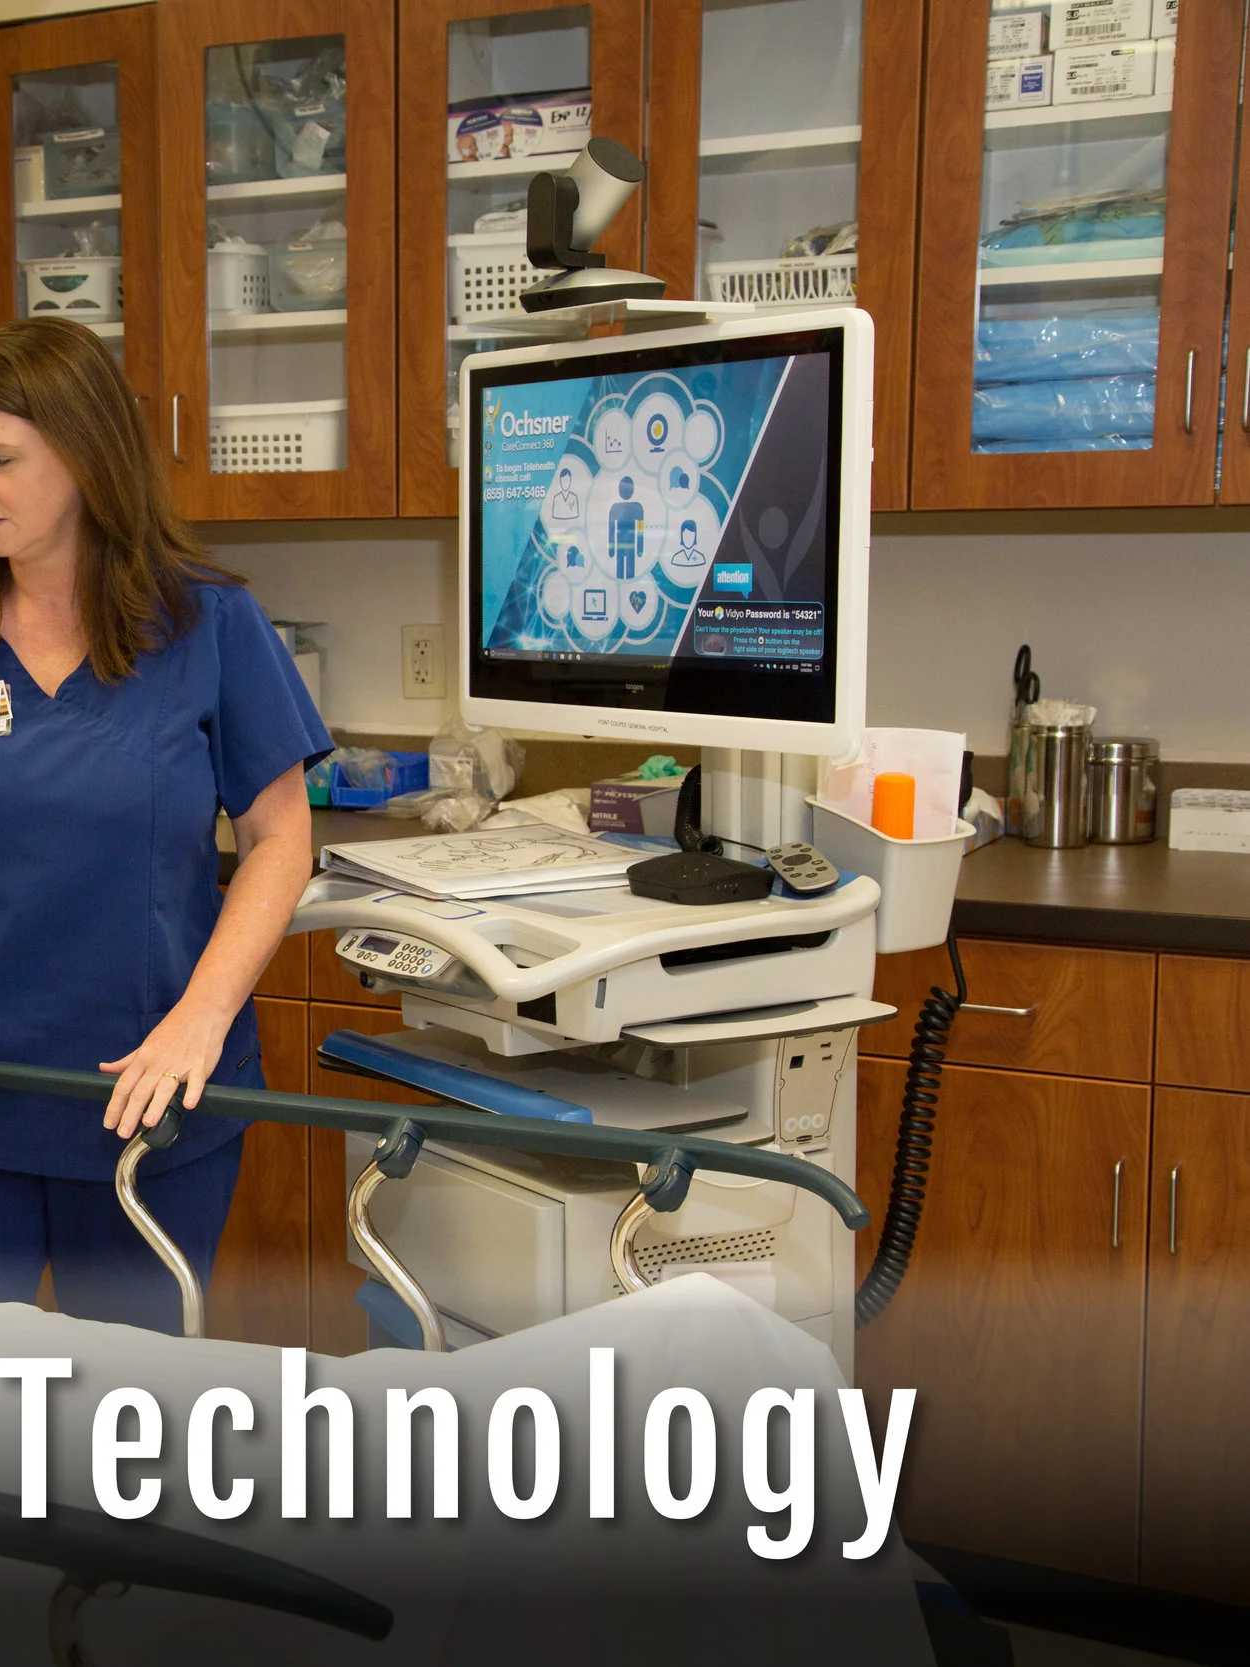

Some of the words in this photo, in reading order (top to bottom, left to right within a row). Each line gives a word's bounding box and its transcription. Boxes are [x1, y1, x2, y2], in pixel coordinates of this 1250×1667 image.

[501, 410, 569, 437] Ochsner
[502, 441, 541, 452] CareConnect
[542, 439, 555, 449] 360
[496, 464, 503, 473] To
[504, 463, 522, 474] begin
[523, 461, 556, 472] Telehealth
[495, 474, 519, 483] consult
[519, 472, 531, 482] call
[483, 487, 504, 502] (855)
[506, 486, 546, 500] 647-5465
[717, 570, 749, 584] attention
[697, 608, 714, 618] Your
[725, 608, 744, 620] Vidyo
[745, 608, 781, 619] Password
[782, 610, 790, 619] is
[730, 626, 757, 635] physician?
[771, 628, 792, 636] speaker
[793, 629, 804, 637] may
[733, 636, 748, 644] Press
[733, 645, 745, 653] right
[746, 645, 757, 653] side
[764, 647, 776, 655] your
[799, 648, 821, 656] speaker
[611, 720, 627, 729] COUPEE
[628, 723, 647, 731] GENERAL
[647, 725, 669, 734] HOSPITAL
[592, 812, 618, 820] NITRILE
